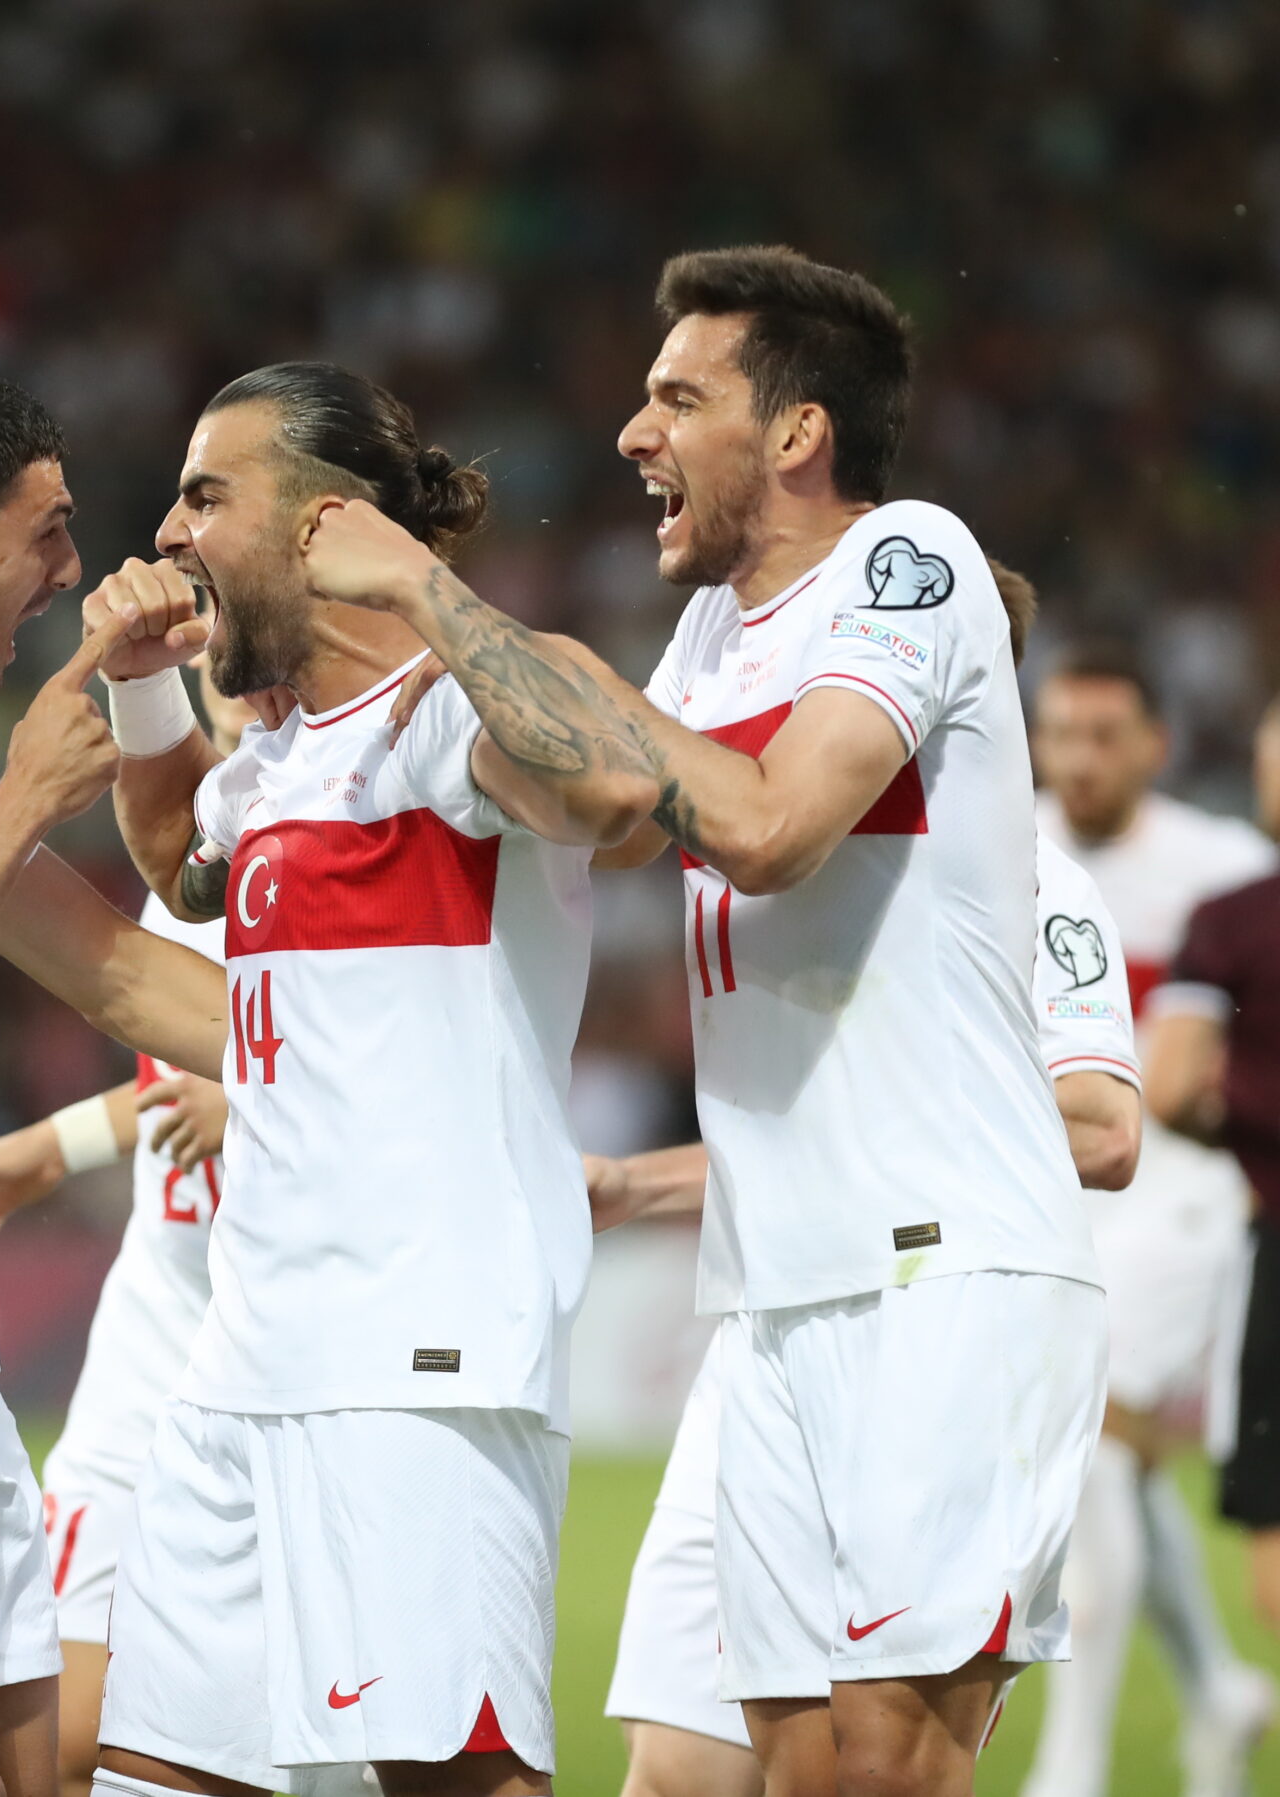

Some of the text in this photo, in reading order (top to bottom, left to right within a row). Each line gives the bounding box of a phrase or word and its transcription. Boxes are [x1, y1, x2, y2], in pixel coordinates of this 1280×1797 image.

[831, 621, 928, 664] FOUNDATION
[695, 880, 737, 998] 11
[231, 969, 285, 1085] 14
